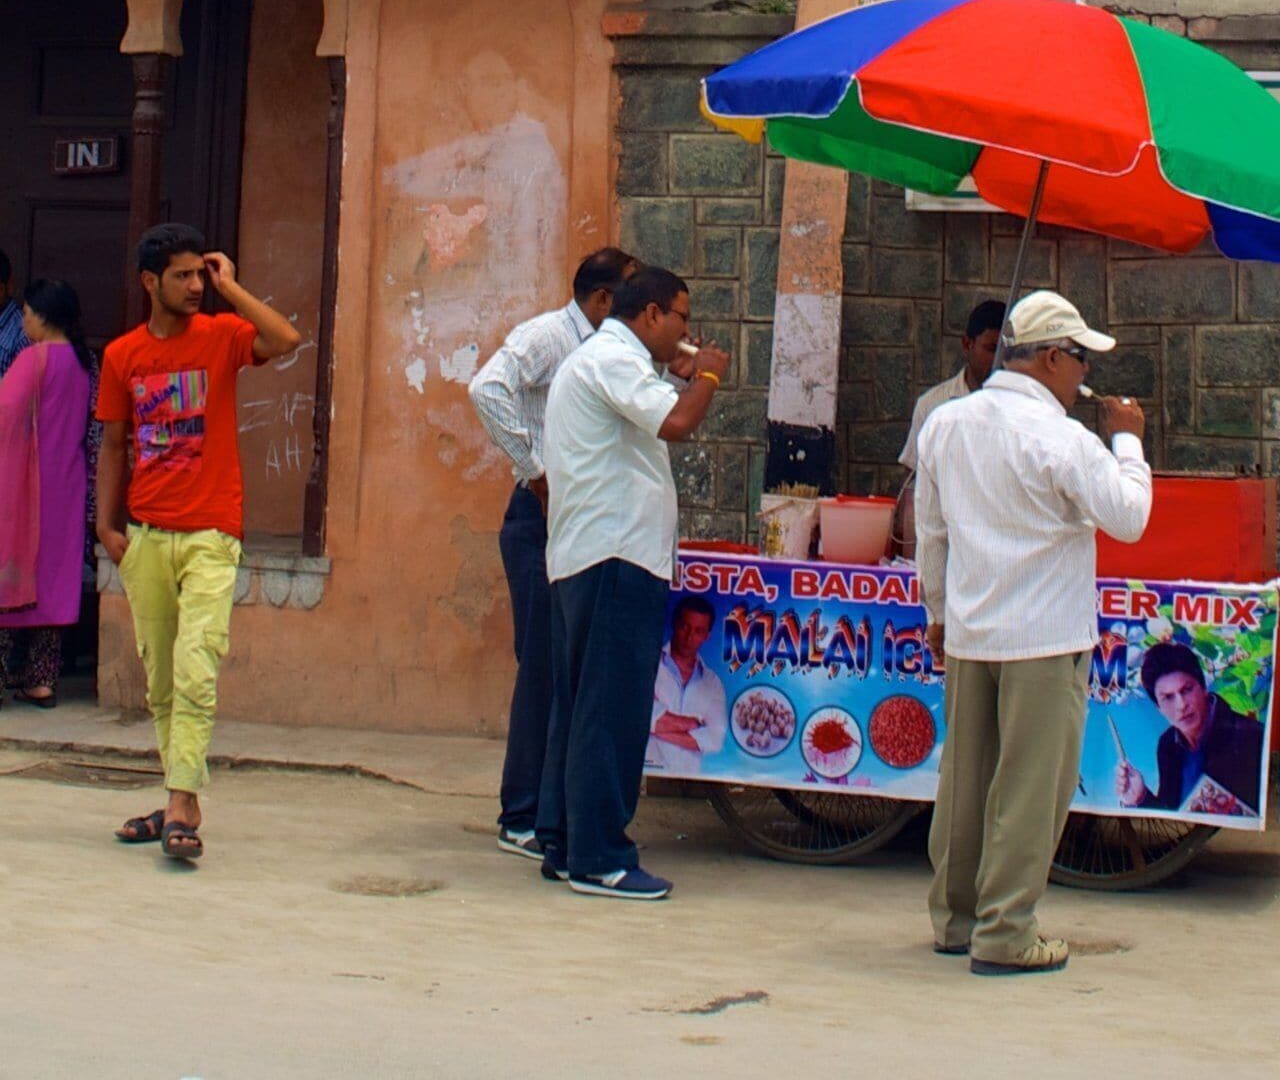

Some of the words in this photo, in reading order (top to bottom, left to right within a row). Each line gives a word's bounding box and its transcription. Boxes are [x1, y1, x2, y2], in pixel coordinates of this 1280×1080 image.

[67, 142, 99, 168] IN
[670, 562, 779, 602] ISTA,
[1173, 593, 1260, 627] MIX
[722, 608, 871, 677] MALAI
